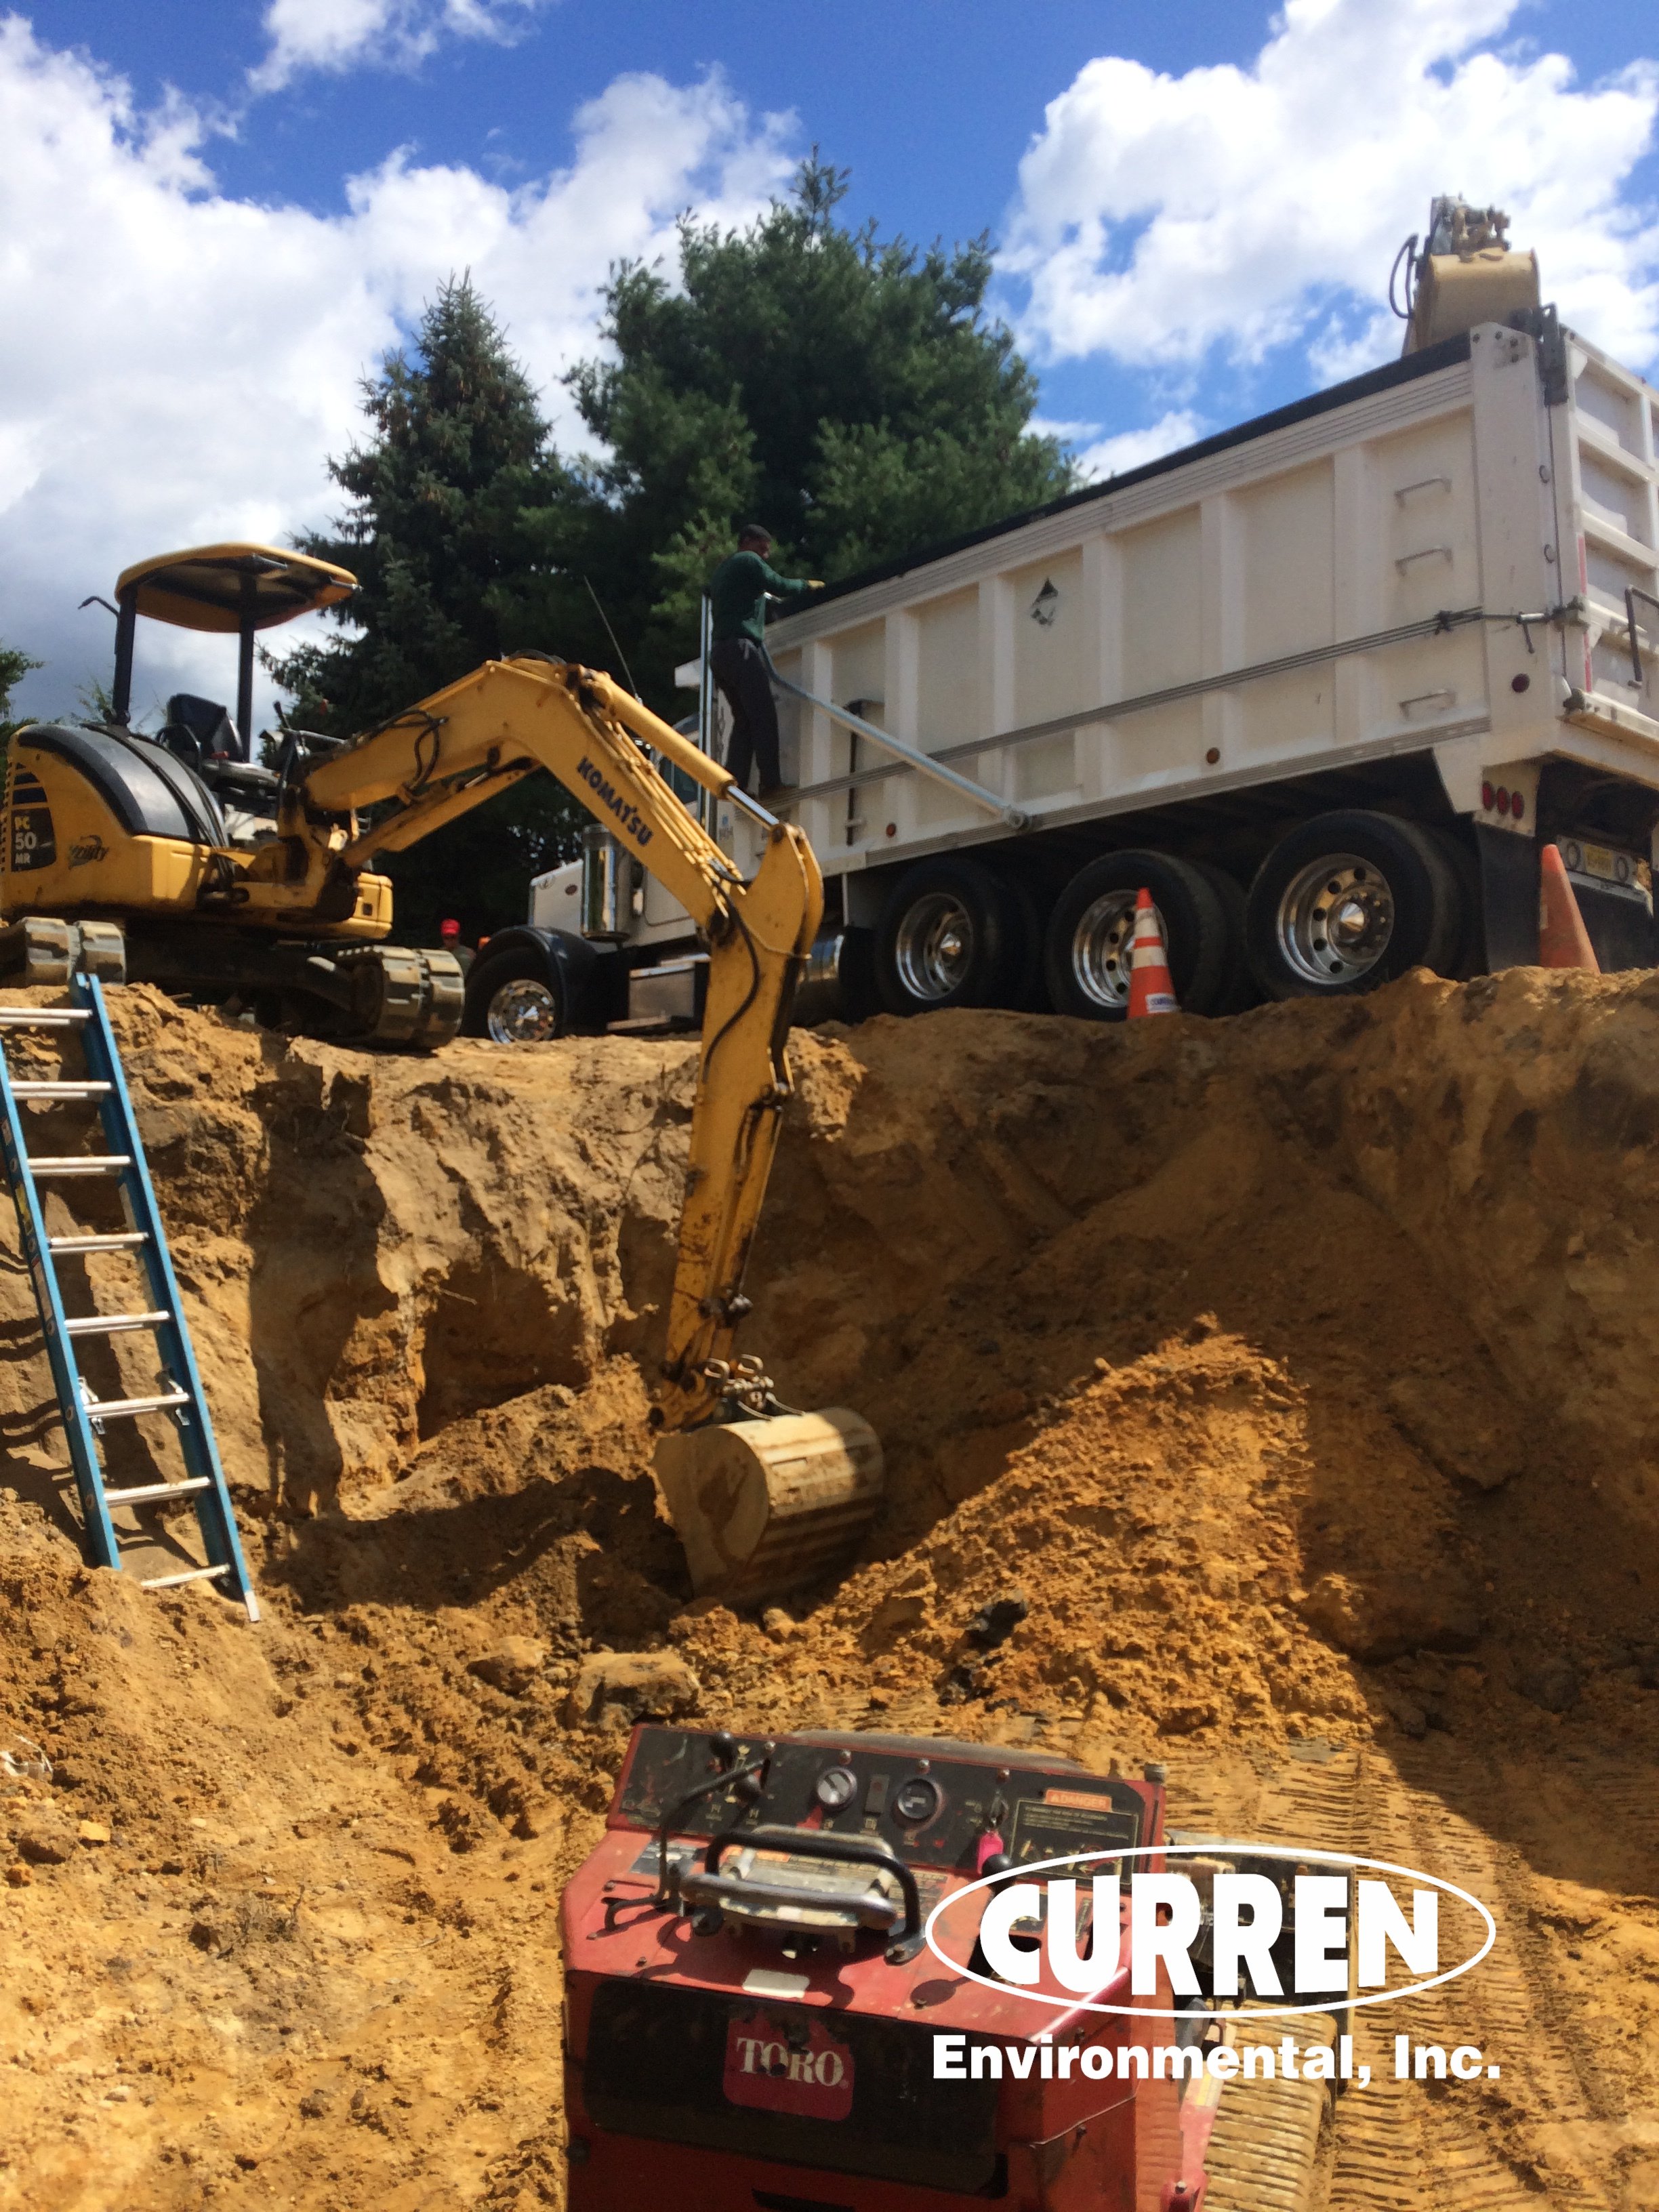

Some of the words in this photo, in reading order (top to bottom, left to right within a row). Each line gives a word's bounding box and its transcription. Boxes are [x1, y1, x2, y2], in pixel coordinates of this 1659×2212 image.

[577, 756, 653, 846] KOMATSU
[14, 816, 30, 830] PC
[15, 832, 37, 850] 50
[15, 853, 31, 864] MR
[1060, 1795, 1107, 1809] DANGER
[737, 2038, 844, 2087] TORO
